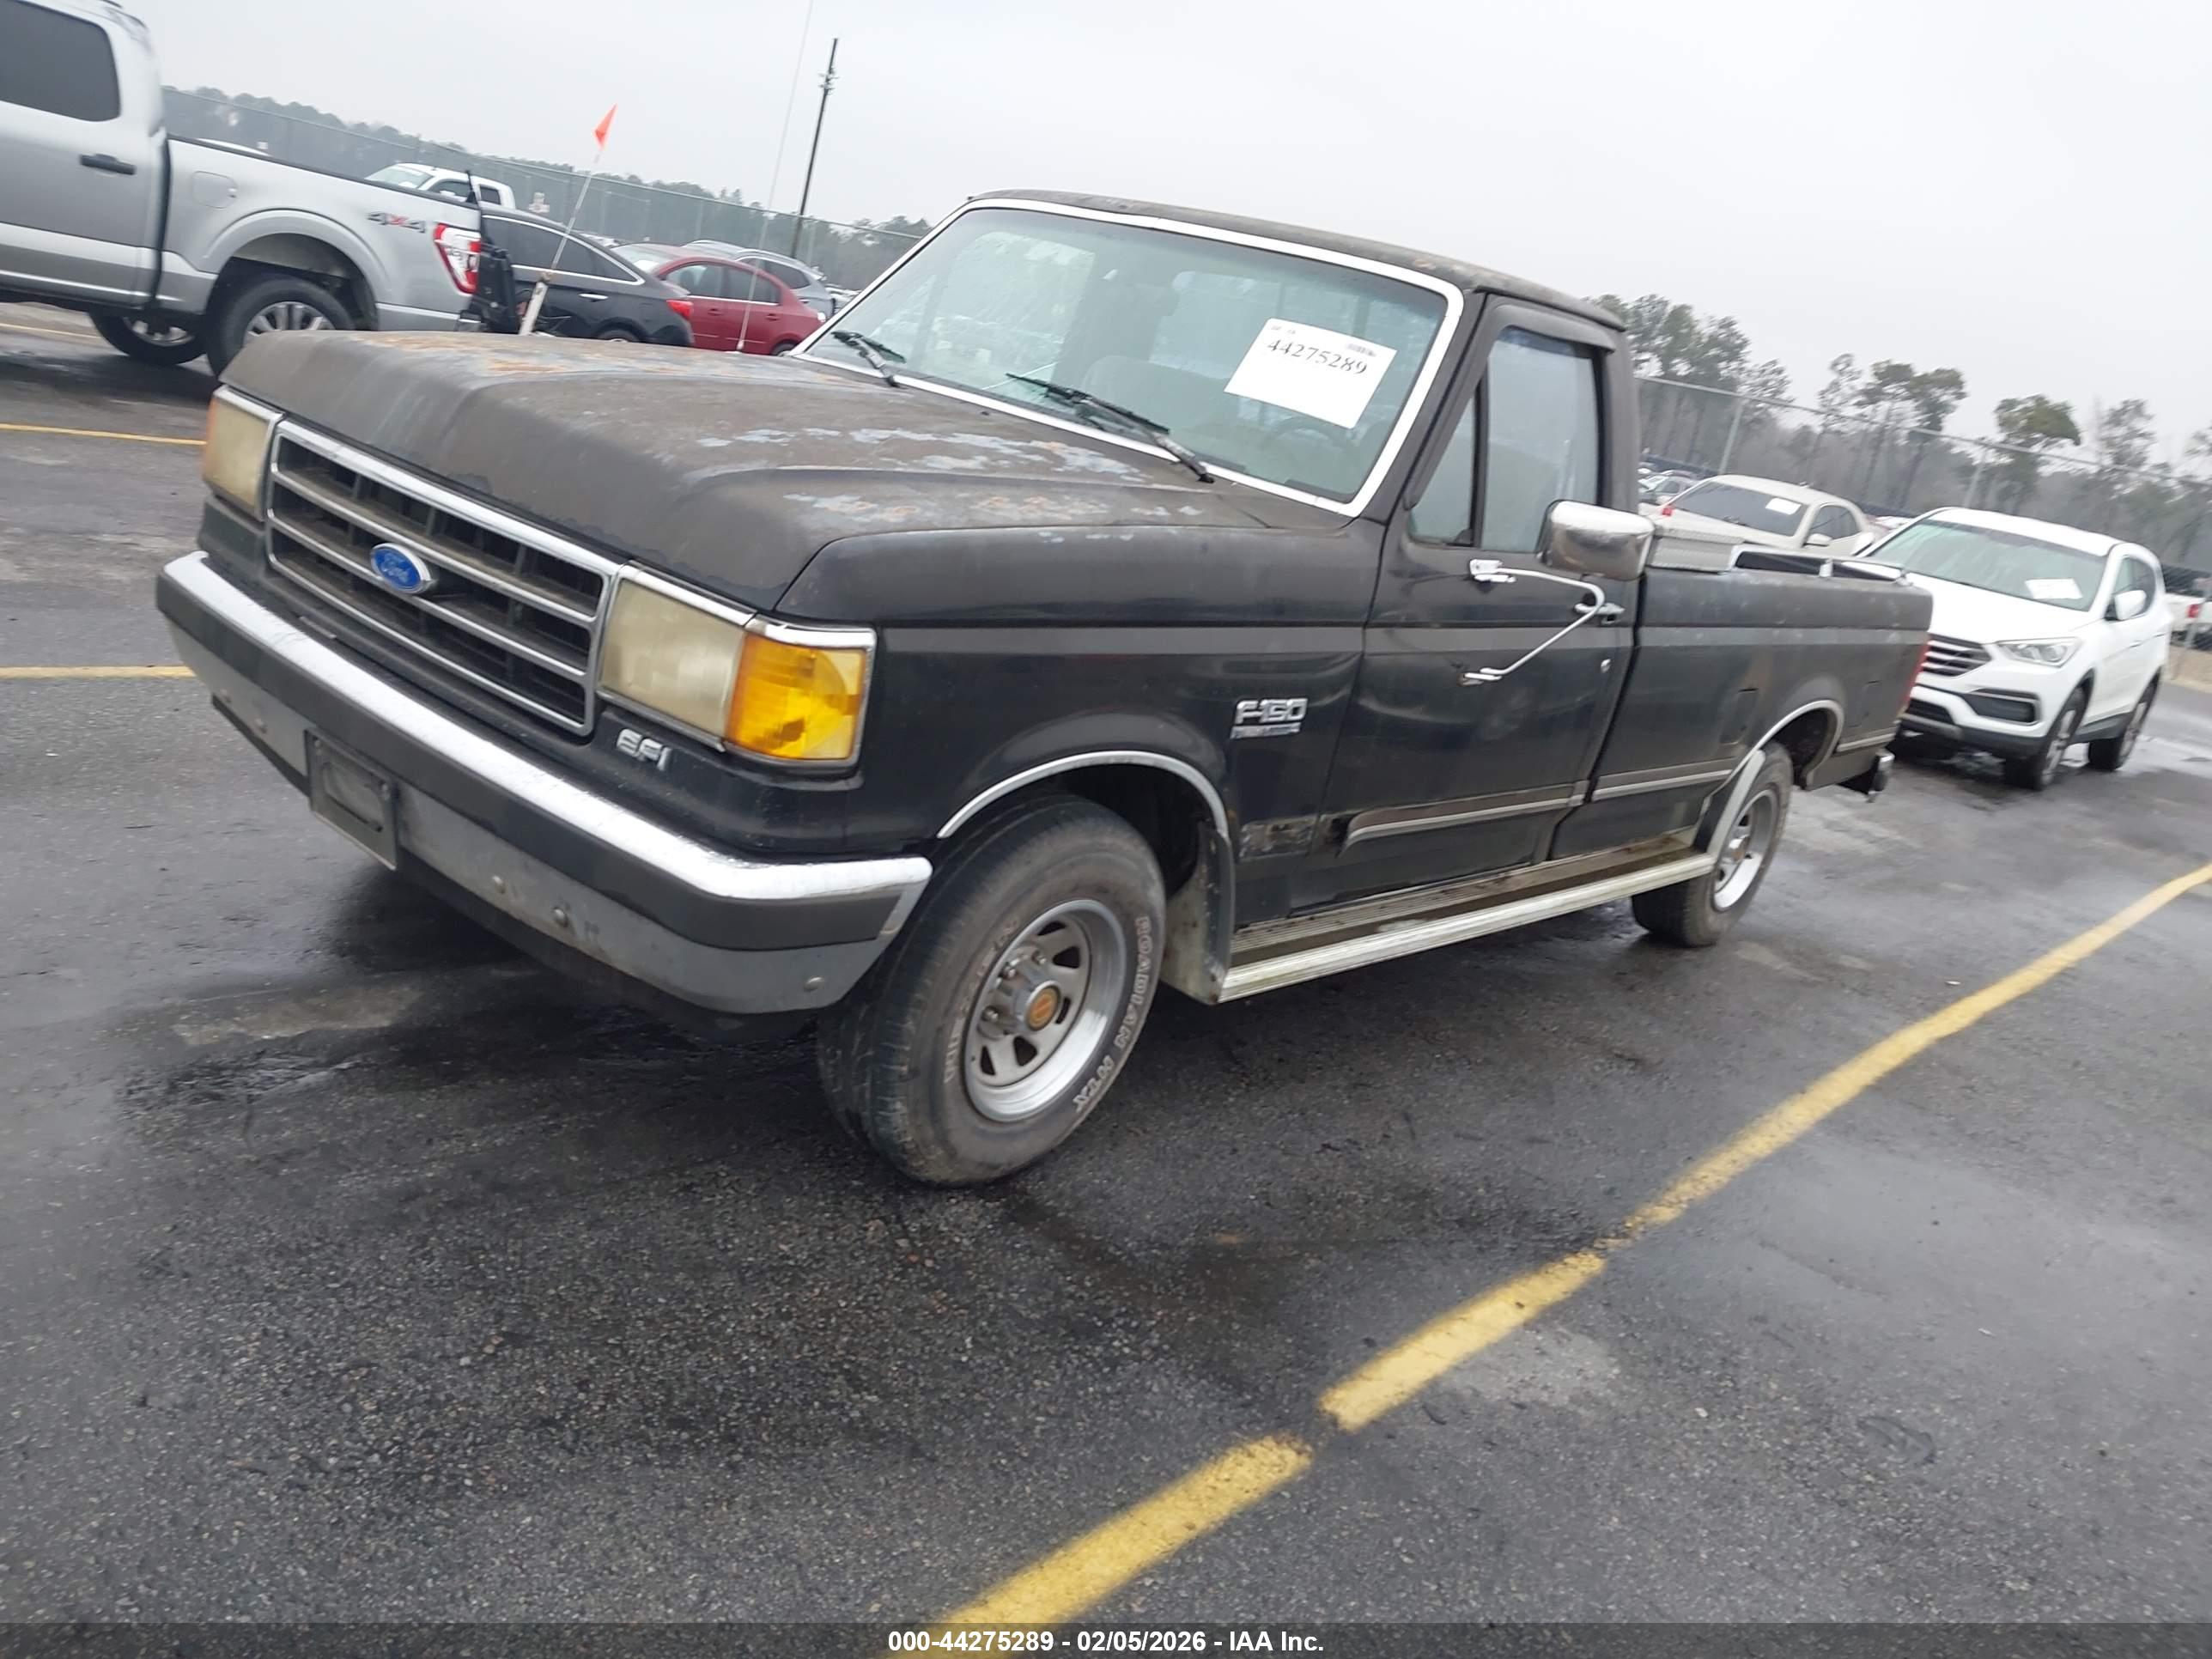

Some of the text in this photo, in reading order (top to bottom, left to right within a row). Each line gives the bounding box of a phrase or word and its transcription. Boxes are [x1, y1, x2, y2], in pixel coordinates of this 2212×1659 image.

[1267, 339, 1368, 374] 44275289
[617, 728, 672, 771] EFI
[1114, 915, 1153, 1048] ROADIAN
